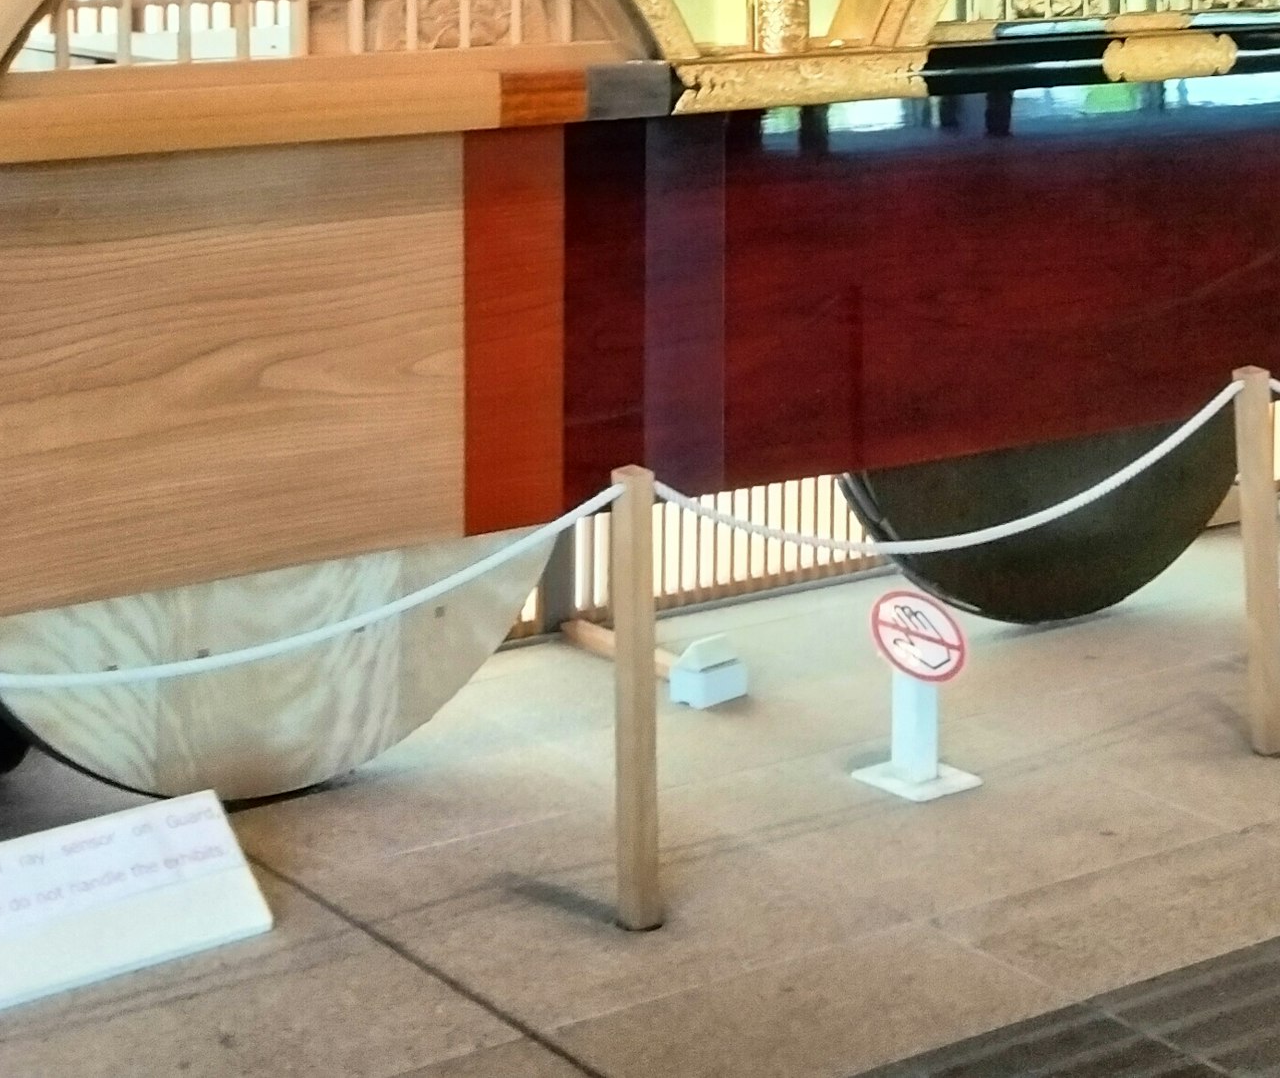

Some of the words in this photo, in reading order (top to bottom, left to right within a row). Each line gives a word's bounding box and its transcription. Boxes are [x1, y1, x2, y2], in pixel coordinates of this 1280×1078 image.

[19, 851, 46, 870] ray
[60, 832, 117, 856] sensor
[8, 895, 32, 912] do
[36, 886, 65, 904] not
[70, 870, 127, 896] handle
[130, 861, 159, 878] the
